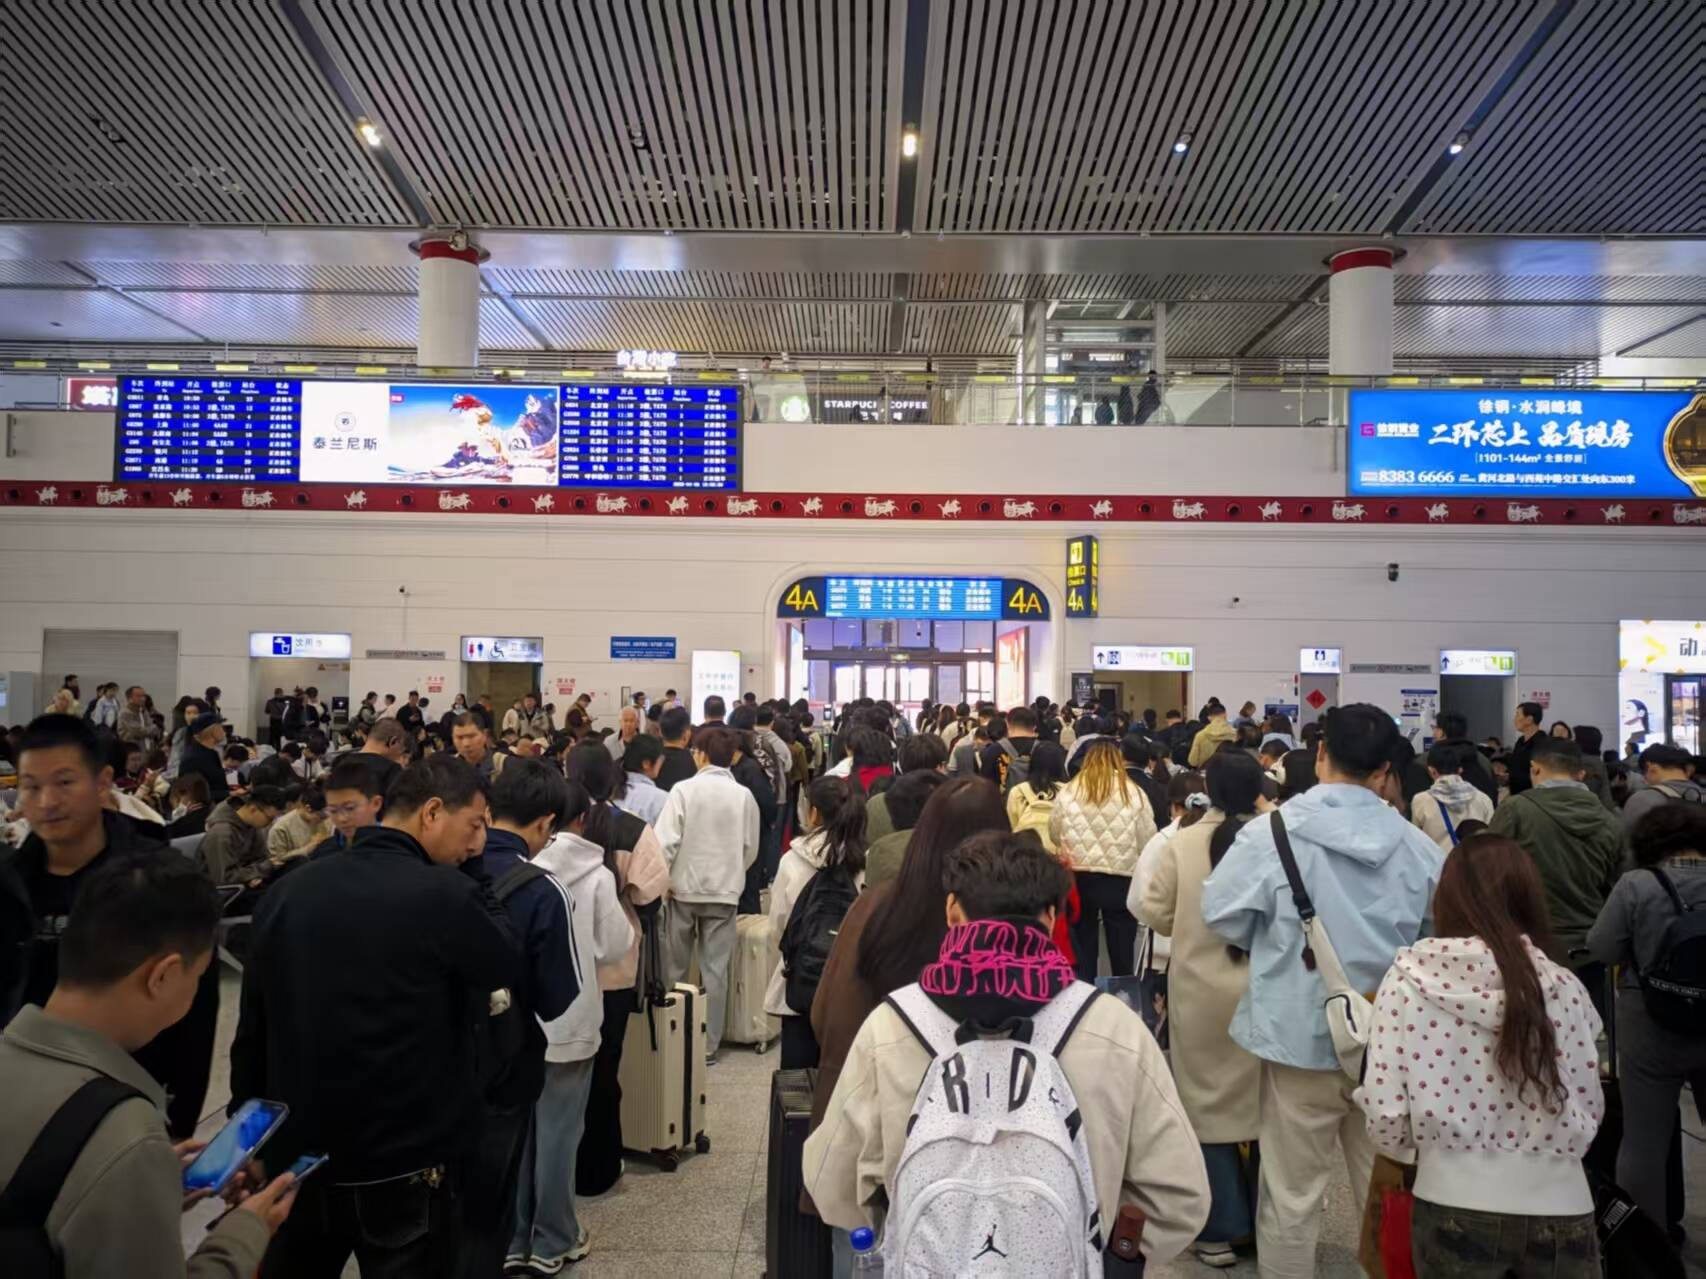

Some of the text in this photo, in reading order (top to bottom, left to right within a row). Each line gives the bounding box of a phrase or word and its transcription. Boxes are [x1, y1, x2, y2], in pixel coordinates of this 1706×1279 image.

[313, 437, 377, 451] 泰兰尼斯
[1428, 420, 1633, 449] 二环芯上 品质现房
[1379, 471, 1414, 483] 8383
[1418, 471, 1455, 483] 6666
[785, 584, 818, 611] 4A
[1009, 587, 1042, 613] 4A
[1068, 589, 1084, 611] 4A
